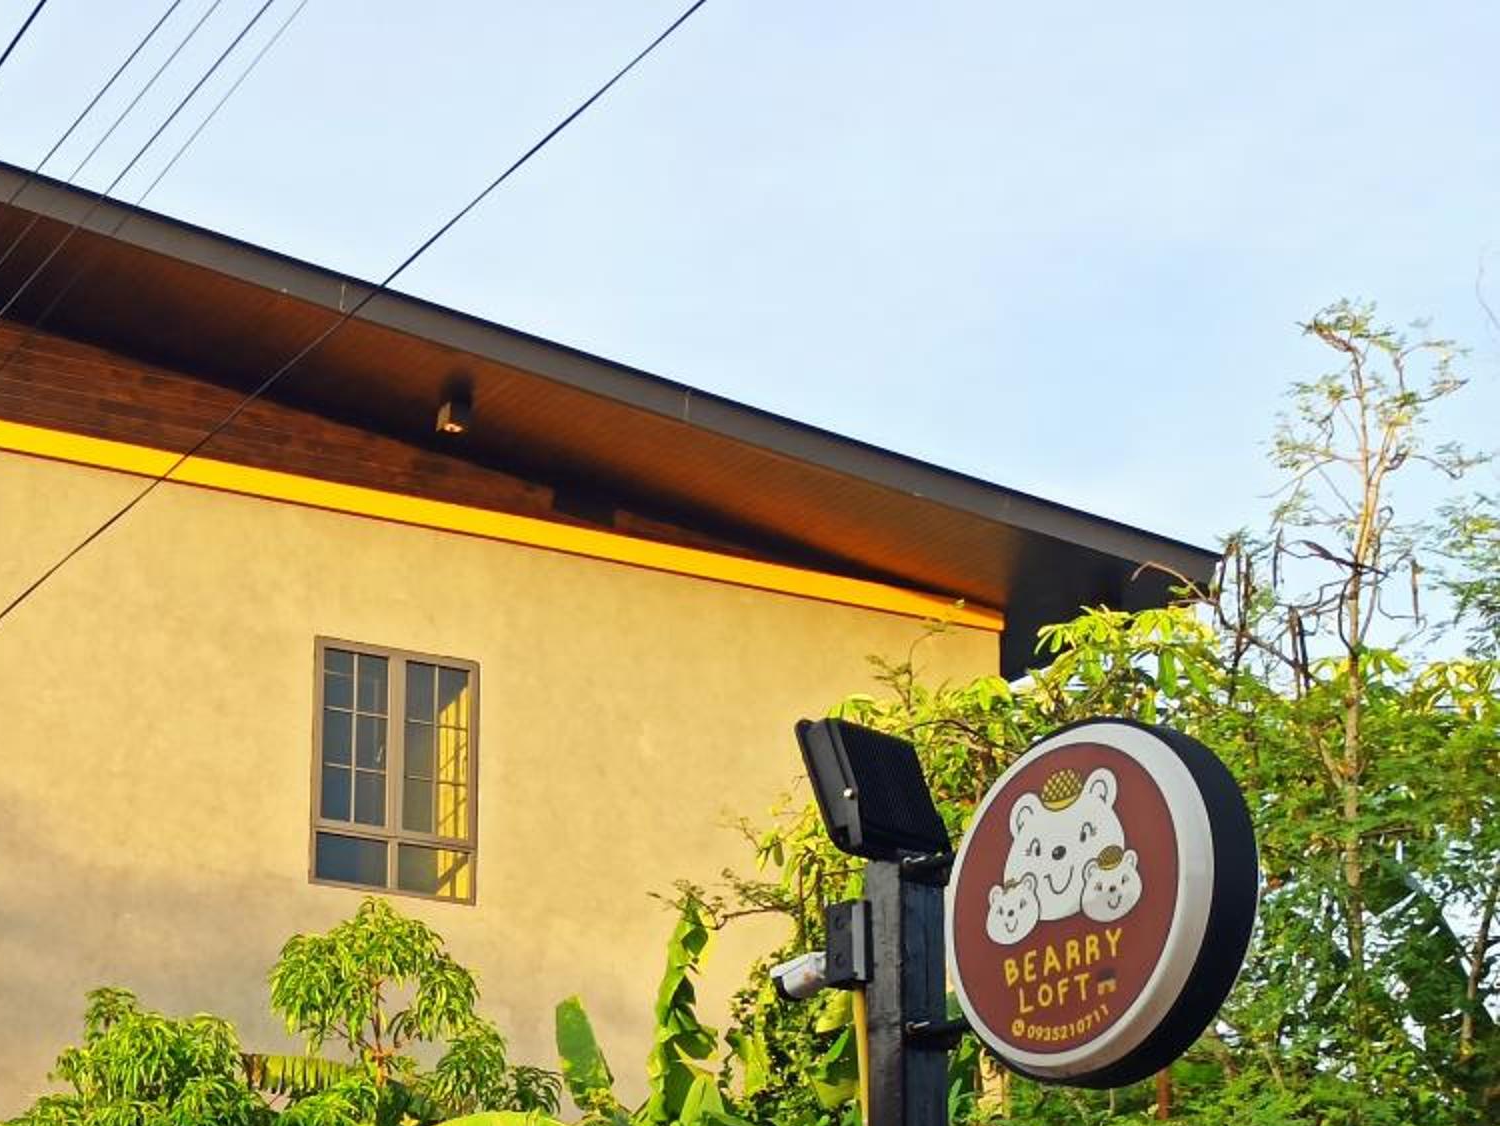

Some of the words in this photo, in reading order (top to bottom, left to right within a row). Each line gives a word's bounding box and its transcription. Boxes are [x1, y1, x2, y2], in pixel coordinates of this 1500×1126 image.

[1004, 928, 1122, 987] BEARRY
[1018, 973, 1090, 1014] LOFT
[1027, 1004, 1109, 1041] 0935210711
